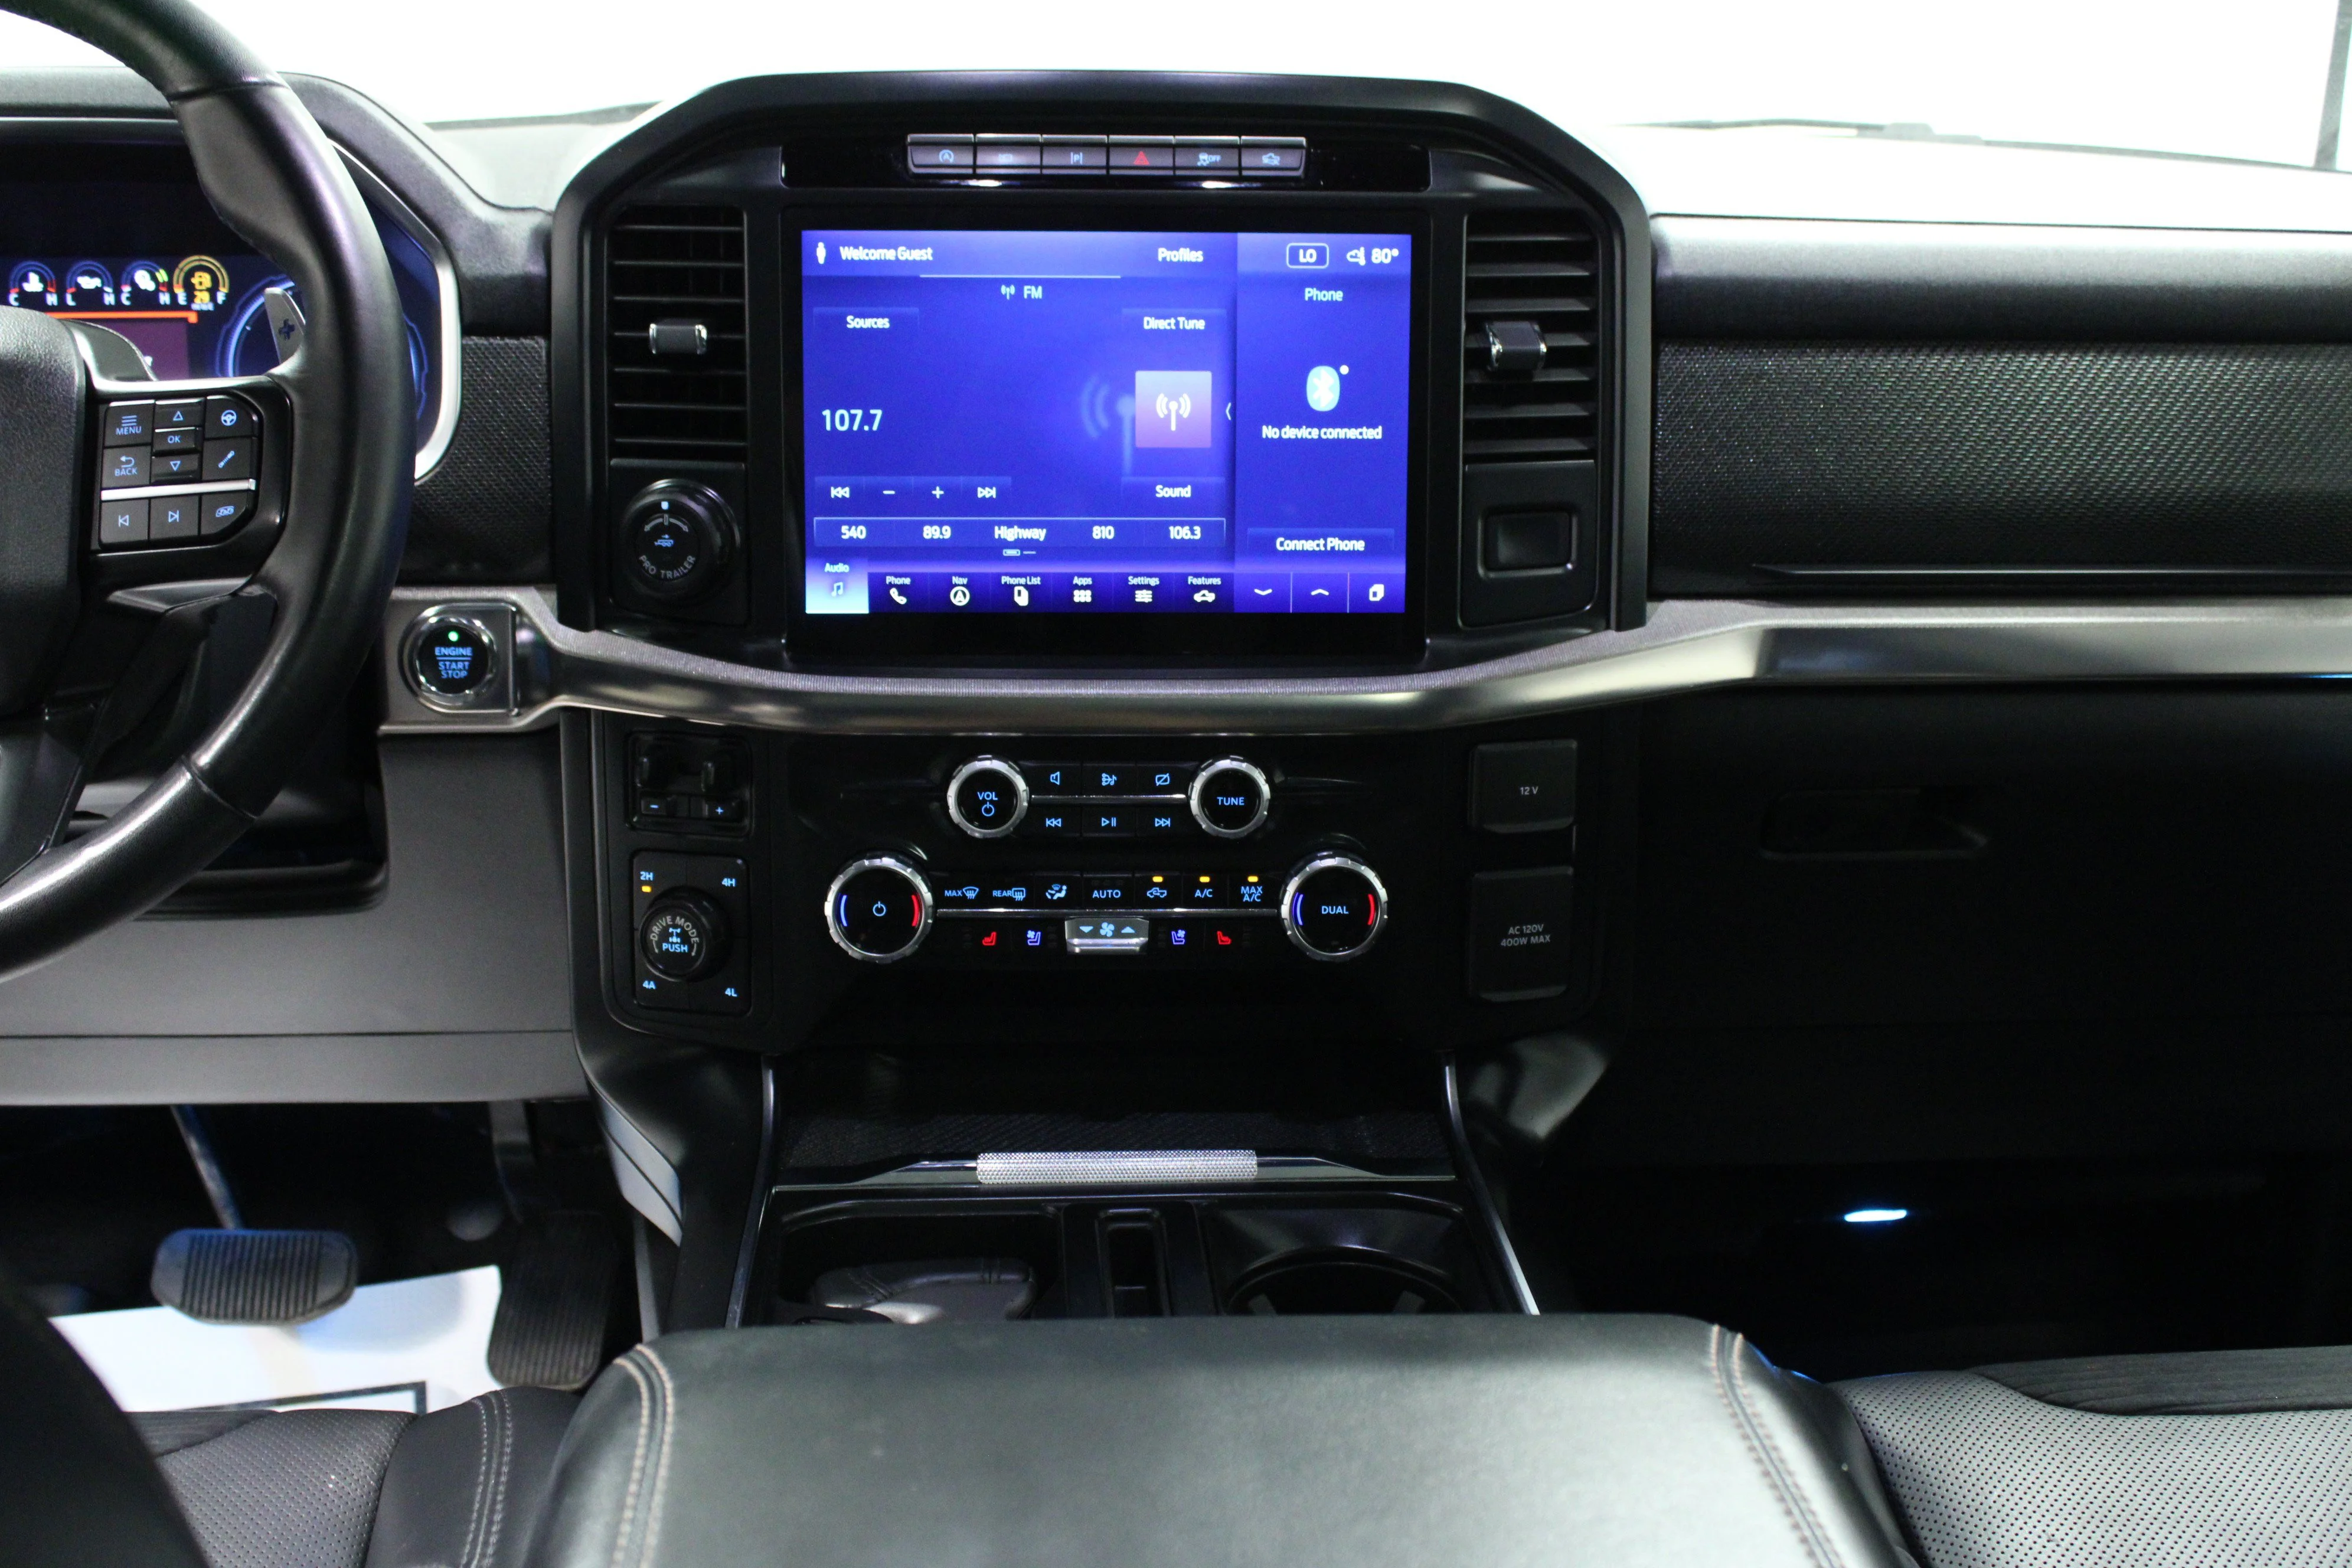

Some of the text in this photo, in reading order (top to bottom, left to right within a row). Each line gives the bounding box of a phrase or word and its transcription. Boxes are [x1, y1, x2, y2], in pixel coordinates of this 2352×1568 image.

[839, 246, 933, 260] Welcome Guest
[1158, 247, 1204, 262] Profiles
[1299, 249, 1317, 262] LO
[217, 291, 227, 305] F
[1024, 286, 1043, 299] FM
[1305, 288, 1343, 301] Phone
[9, 293, 19, 306] C
[46, 293, 58, 306] H
[66, 293, 76, 306] L
[103, 293, 115, 306] H
[120, 293, 131, 306] C
[159, 293, 170, 306] H
[847, 315, 890, 329] Sources
[1144, 317, 1205, 330] Direct Tune
[822, 410, 883, 431] 107.7
[116, 426, 142, 435] MENU
[1262, 426, 1383, 439] No device connected
[115, 467, 137, 476] BACK
[1155, 485, 1191, 498] Sound
[841, 525, 866, 540] 540
[923, 525, 952, 540] 89.9
[994, 525, 1047, 542] Highway
[1092, 525, 1115, 540] 810
[1169, 525, 1201, 540] 106.3
[1276, 537, 1365, 551] Connect Phone
[639, 555, 696, 579] PRO TRAILER
[825, 563, 850, 573] Audio
[886, 576, 911, 585] Phone
[952, 576, 968, 585] Nav
[1001, 576, 1041, 585] Phone List
[1073, 576, 1092, 587] Apps
[1128, 576, 1159, 586] Settings
[1188, 576, 1221, 585] Features
[435, 646, 472, 655] ENGINE
[439, 661, 469, 670] START
[441, 670, 468, 679] STOP
[977, 792, 998, 801] VOL
[1520, 786, 1538, 795] 12 V
[1217, 797, 1244, 806] TUNE
[640, 871, 654, 881] 2H
[721, 878, 736, 887] 4H
[1092, 890, 1121, 899] AUTO
[1194, 889, 1213, 899] A/C
[1243, 894, 1261, 903] A/C
[1321, 906, 1349, 914] DUAL
[649, 916, 699, 943] DRIVE MODE
[1508, 924, 1544, 935] AC 120V
[1501, 934, 1550, 946] 400W MAX
[662, 943, 688, 953] PUSH
[642, 980, 656, 989] 4A
[725, 987, 738, 997] 4L
